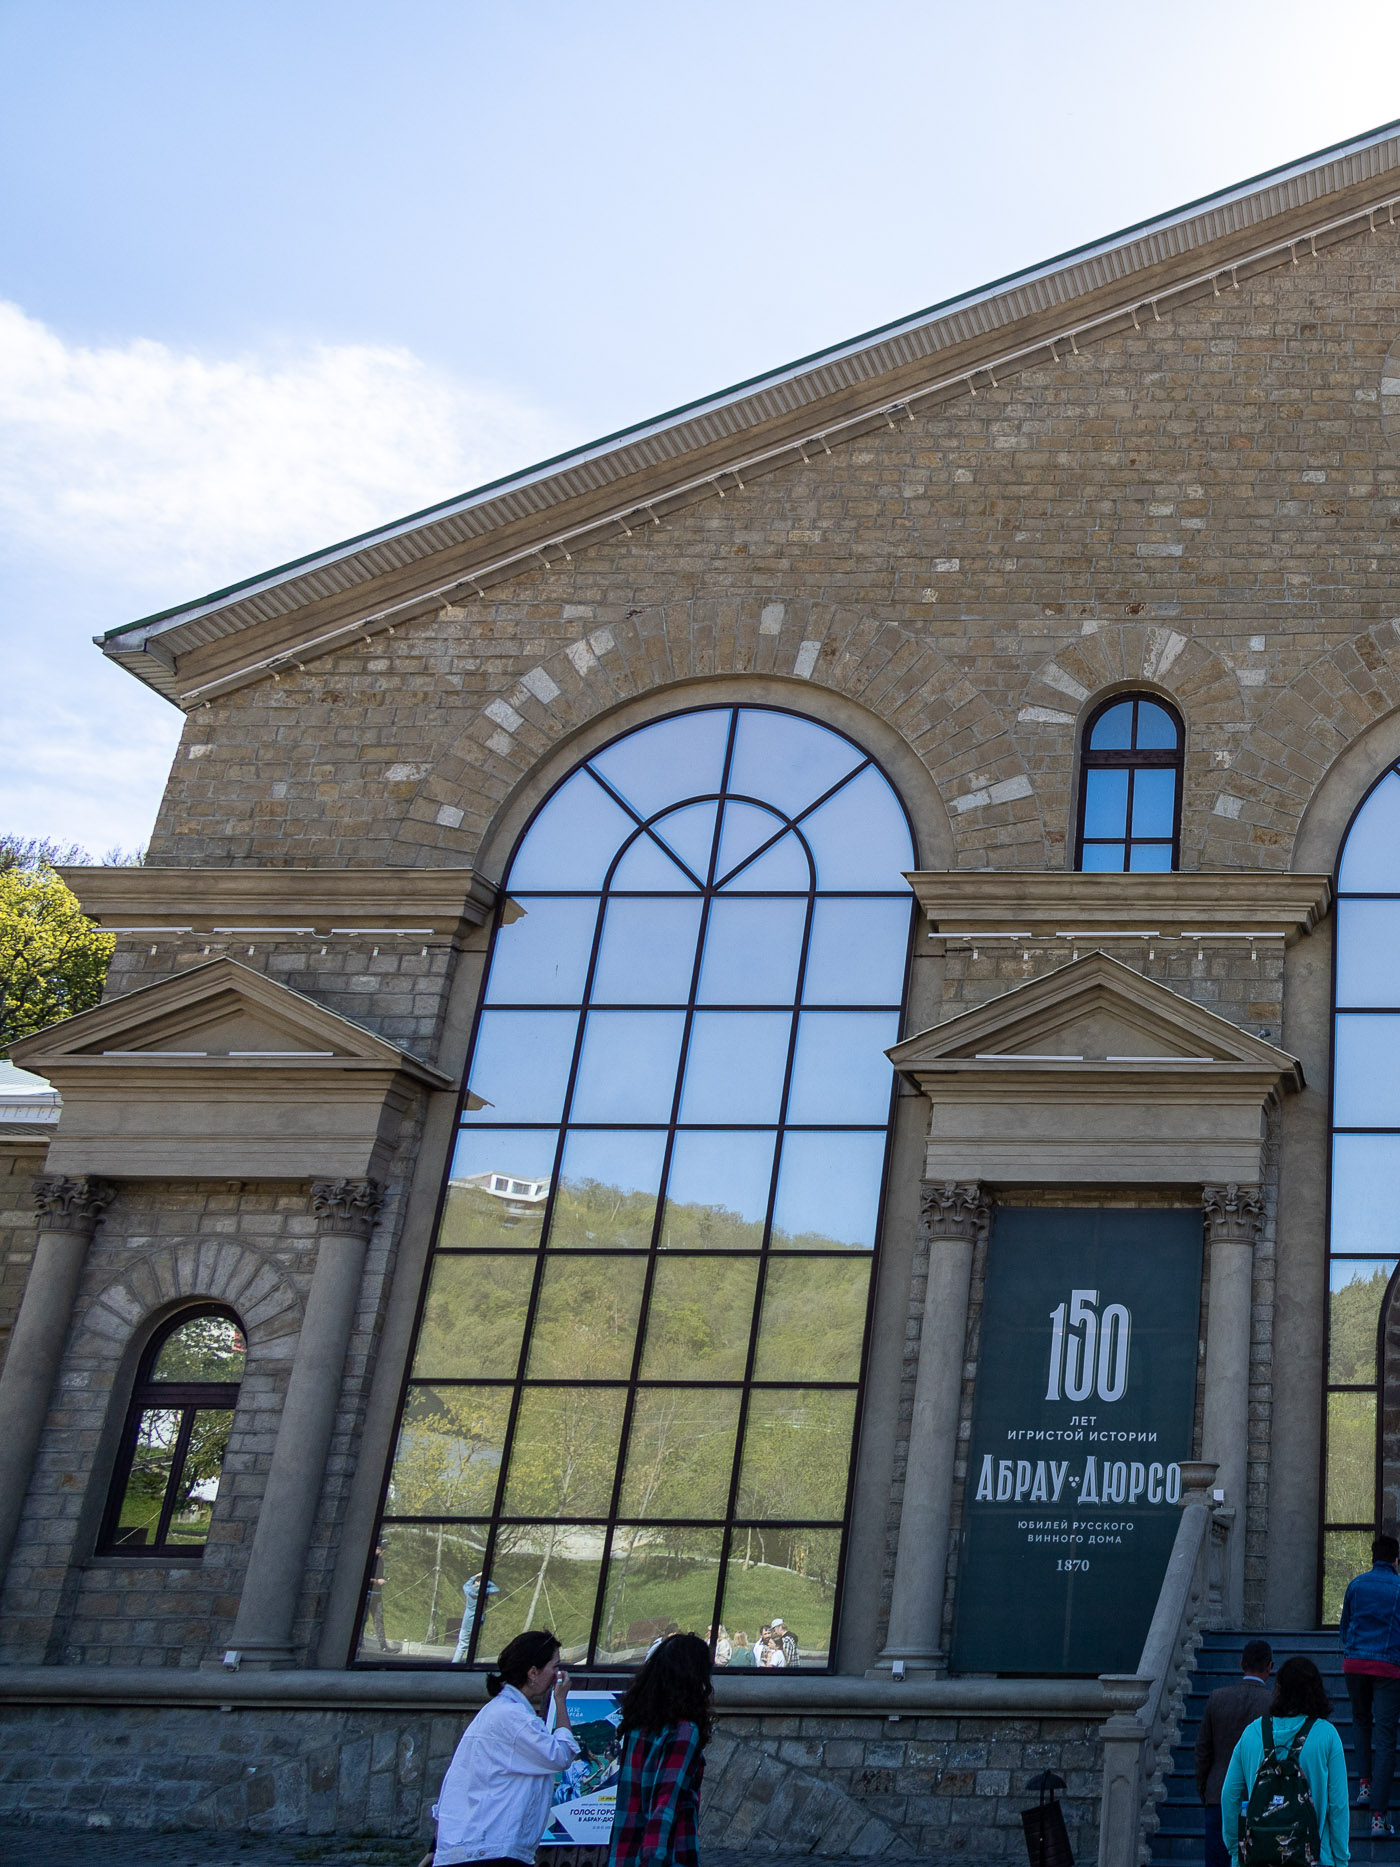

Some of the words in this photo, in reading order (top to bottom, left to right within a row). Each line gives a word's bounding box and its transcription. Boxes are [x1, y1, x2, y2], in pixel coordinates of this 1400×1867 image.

[1045, 1289, 1131, 1403] 150
[1070, 1416, 1097, 1427] ЛЕТ
[1007, 1428, 1084, 1441] ИГРИСТОЙ
[1089, 1431, 1158, 1442] ИСТОРИИ
[1017, 1519, 1068, 1530] ЮБИЛЕЙ
[1073, 1521, 1134, 1531] РУССКОГО
[1027, 1534, 1084, 1543] ВИННОГО
[1088, 1535, 1122, 1544] ДОМА
[1056, 1559, 1090, 1572] 1870
